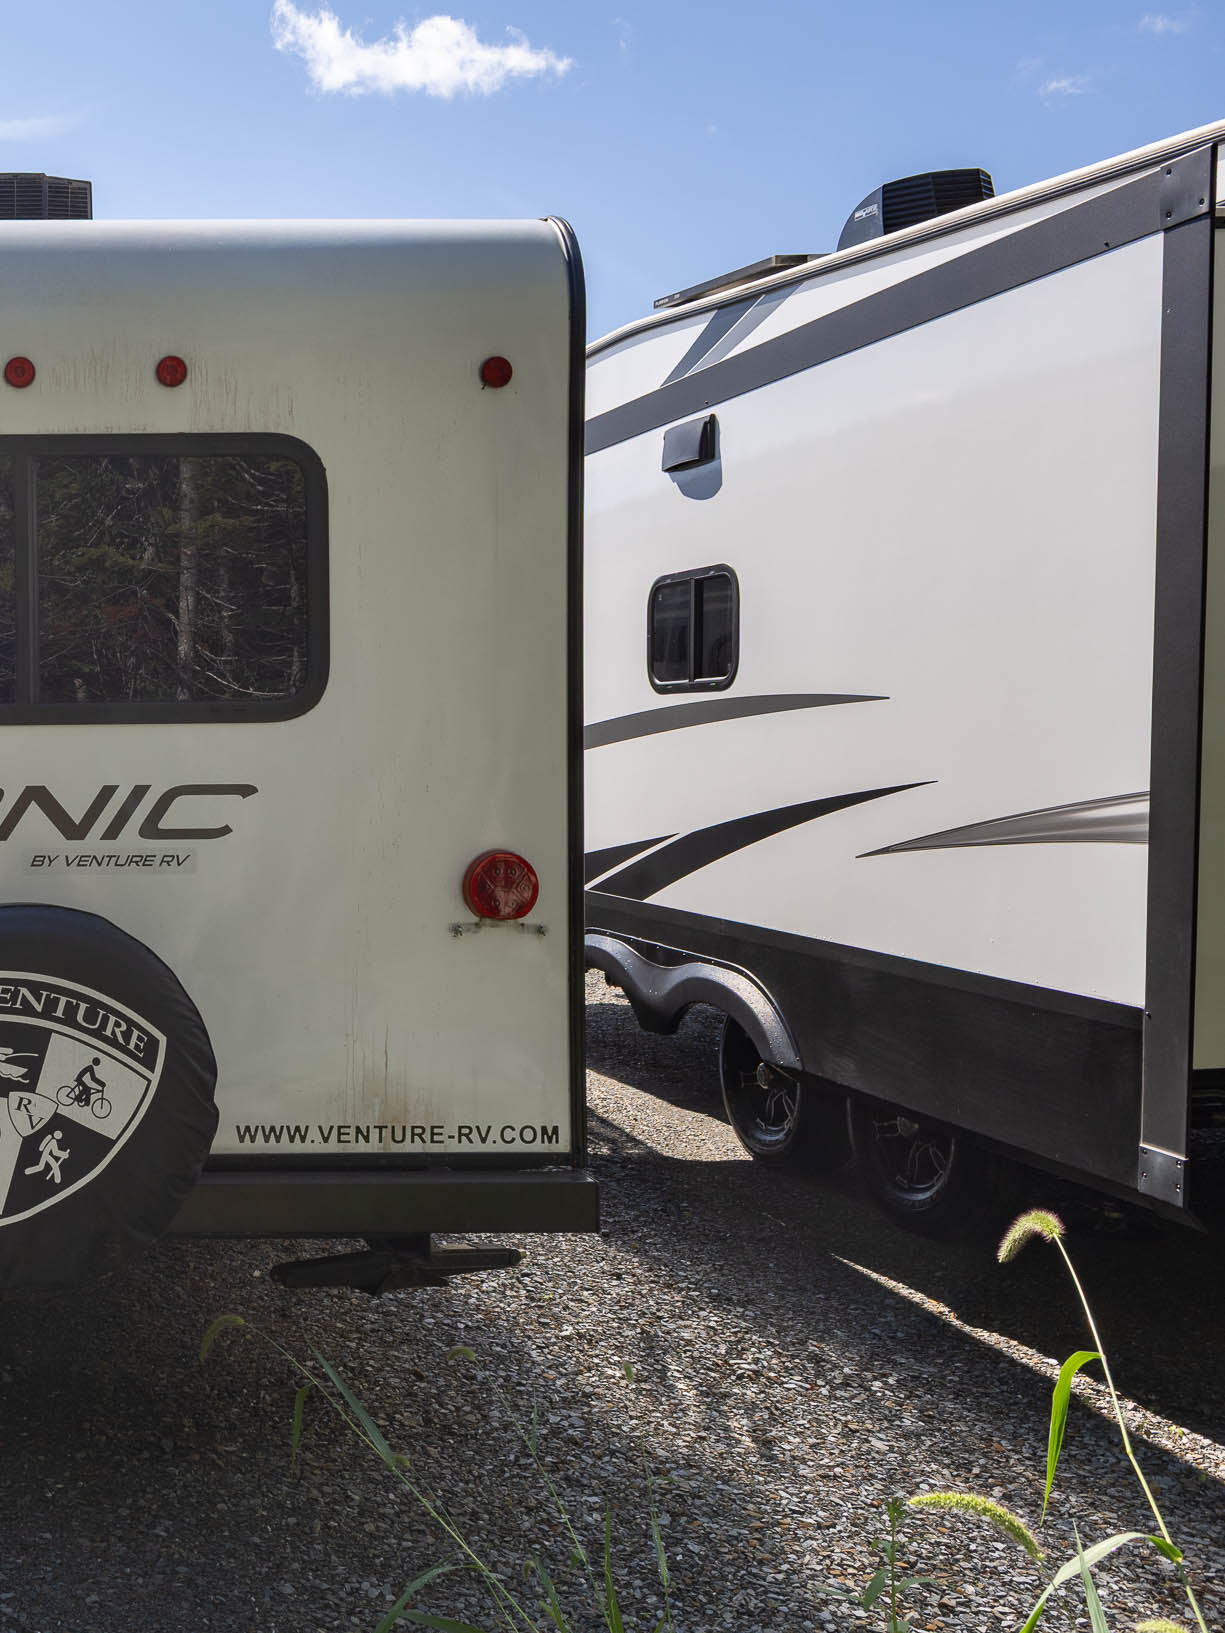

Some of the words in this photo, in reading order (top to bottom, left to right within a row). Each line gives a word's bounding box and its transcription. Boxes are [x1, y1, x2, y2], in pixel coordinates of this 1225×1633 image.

[30, 854, 59, 868] BY
[64, 854, 157, 868] VENTURE
[159, 854, 191, 868] RV
[235, 1124, 560, 1146] WWW.VENTURE-RV.COM
